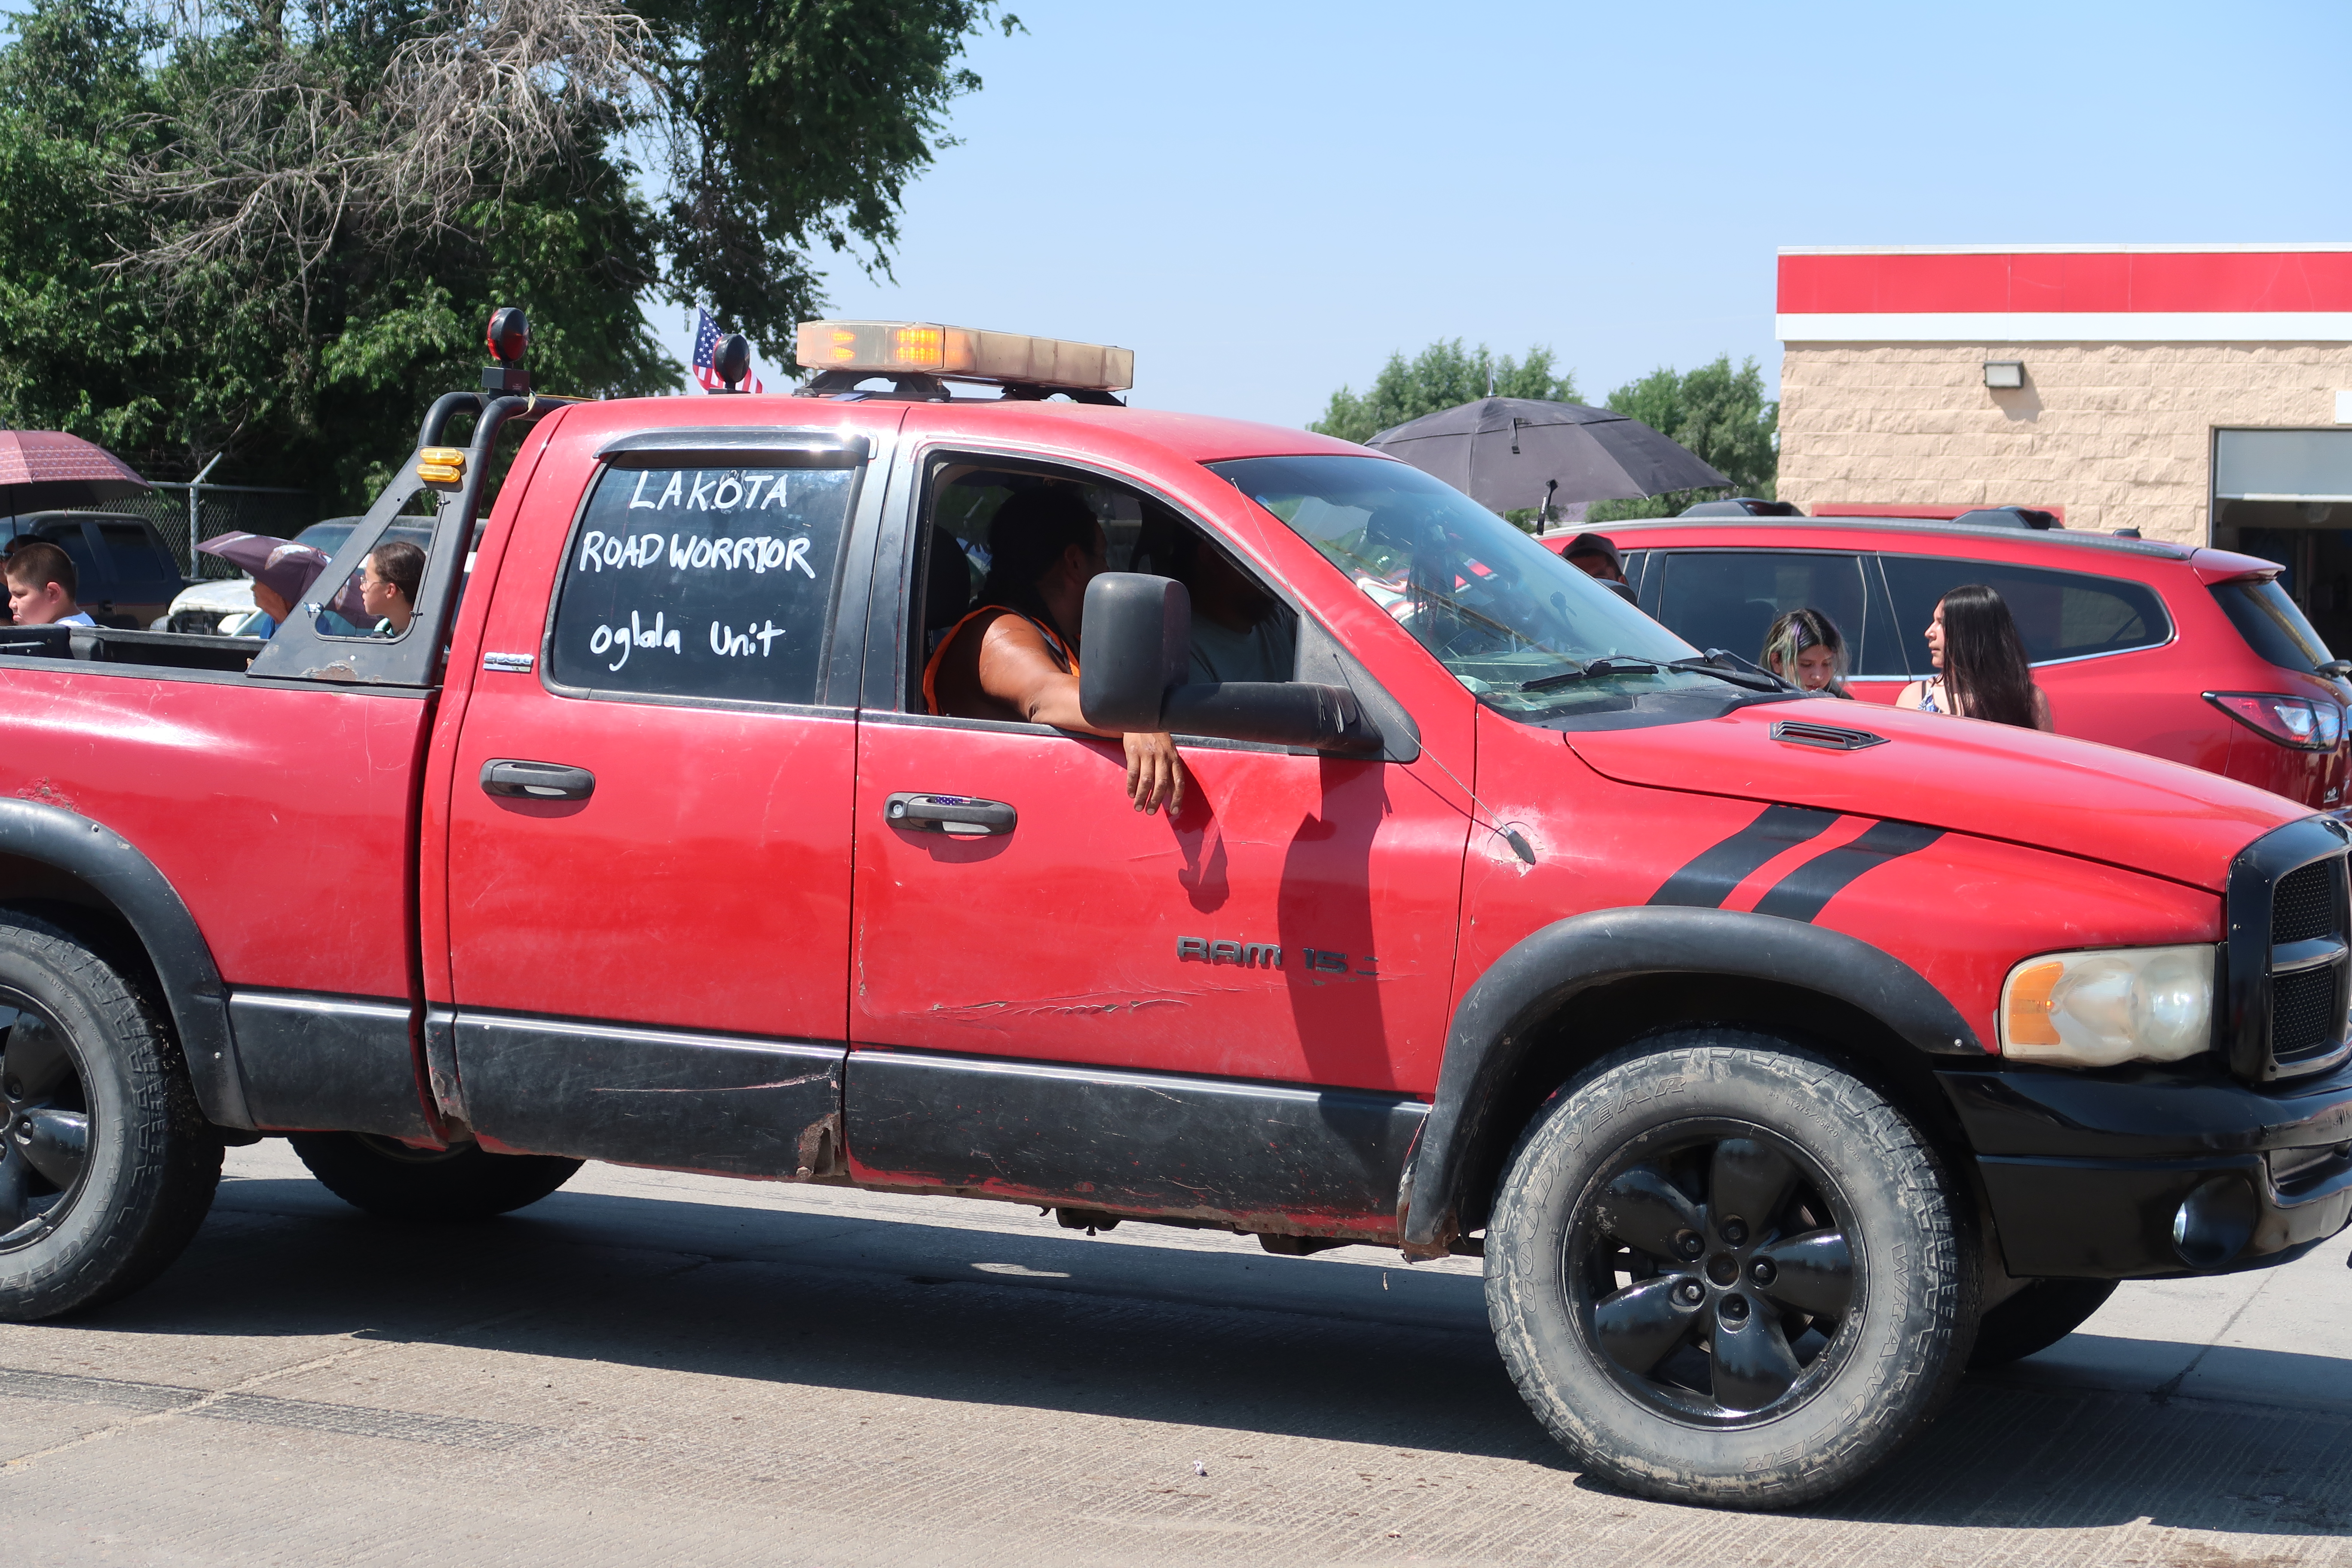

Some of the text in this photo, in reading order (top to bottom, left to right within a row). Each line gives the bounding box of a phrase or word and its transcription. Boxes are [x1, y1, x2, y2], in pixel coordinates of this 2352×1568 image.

[629, 470, 788, 511] LAKOTA
[579, 530, 816, 579] ROAD WORRIOR
[1177, 936, 1282, 966] RAM
[1785, 1097, 1839, 1138] LT275/65R20
[0, 1118, 125, 1289] WRANGLE
[1519, 1076, 1687, 1313] GOODYEAR
[1742, 1243, 1910, 1473] WRANGLER
